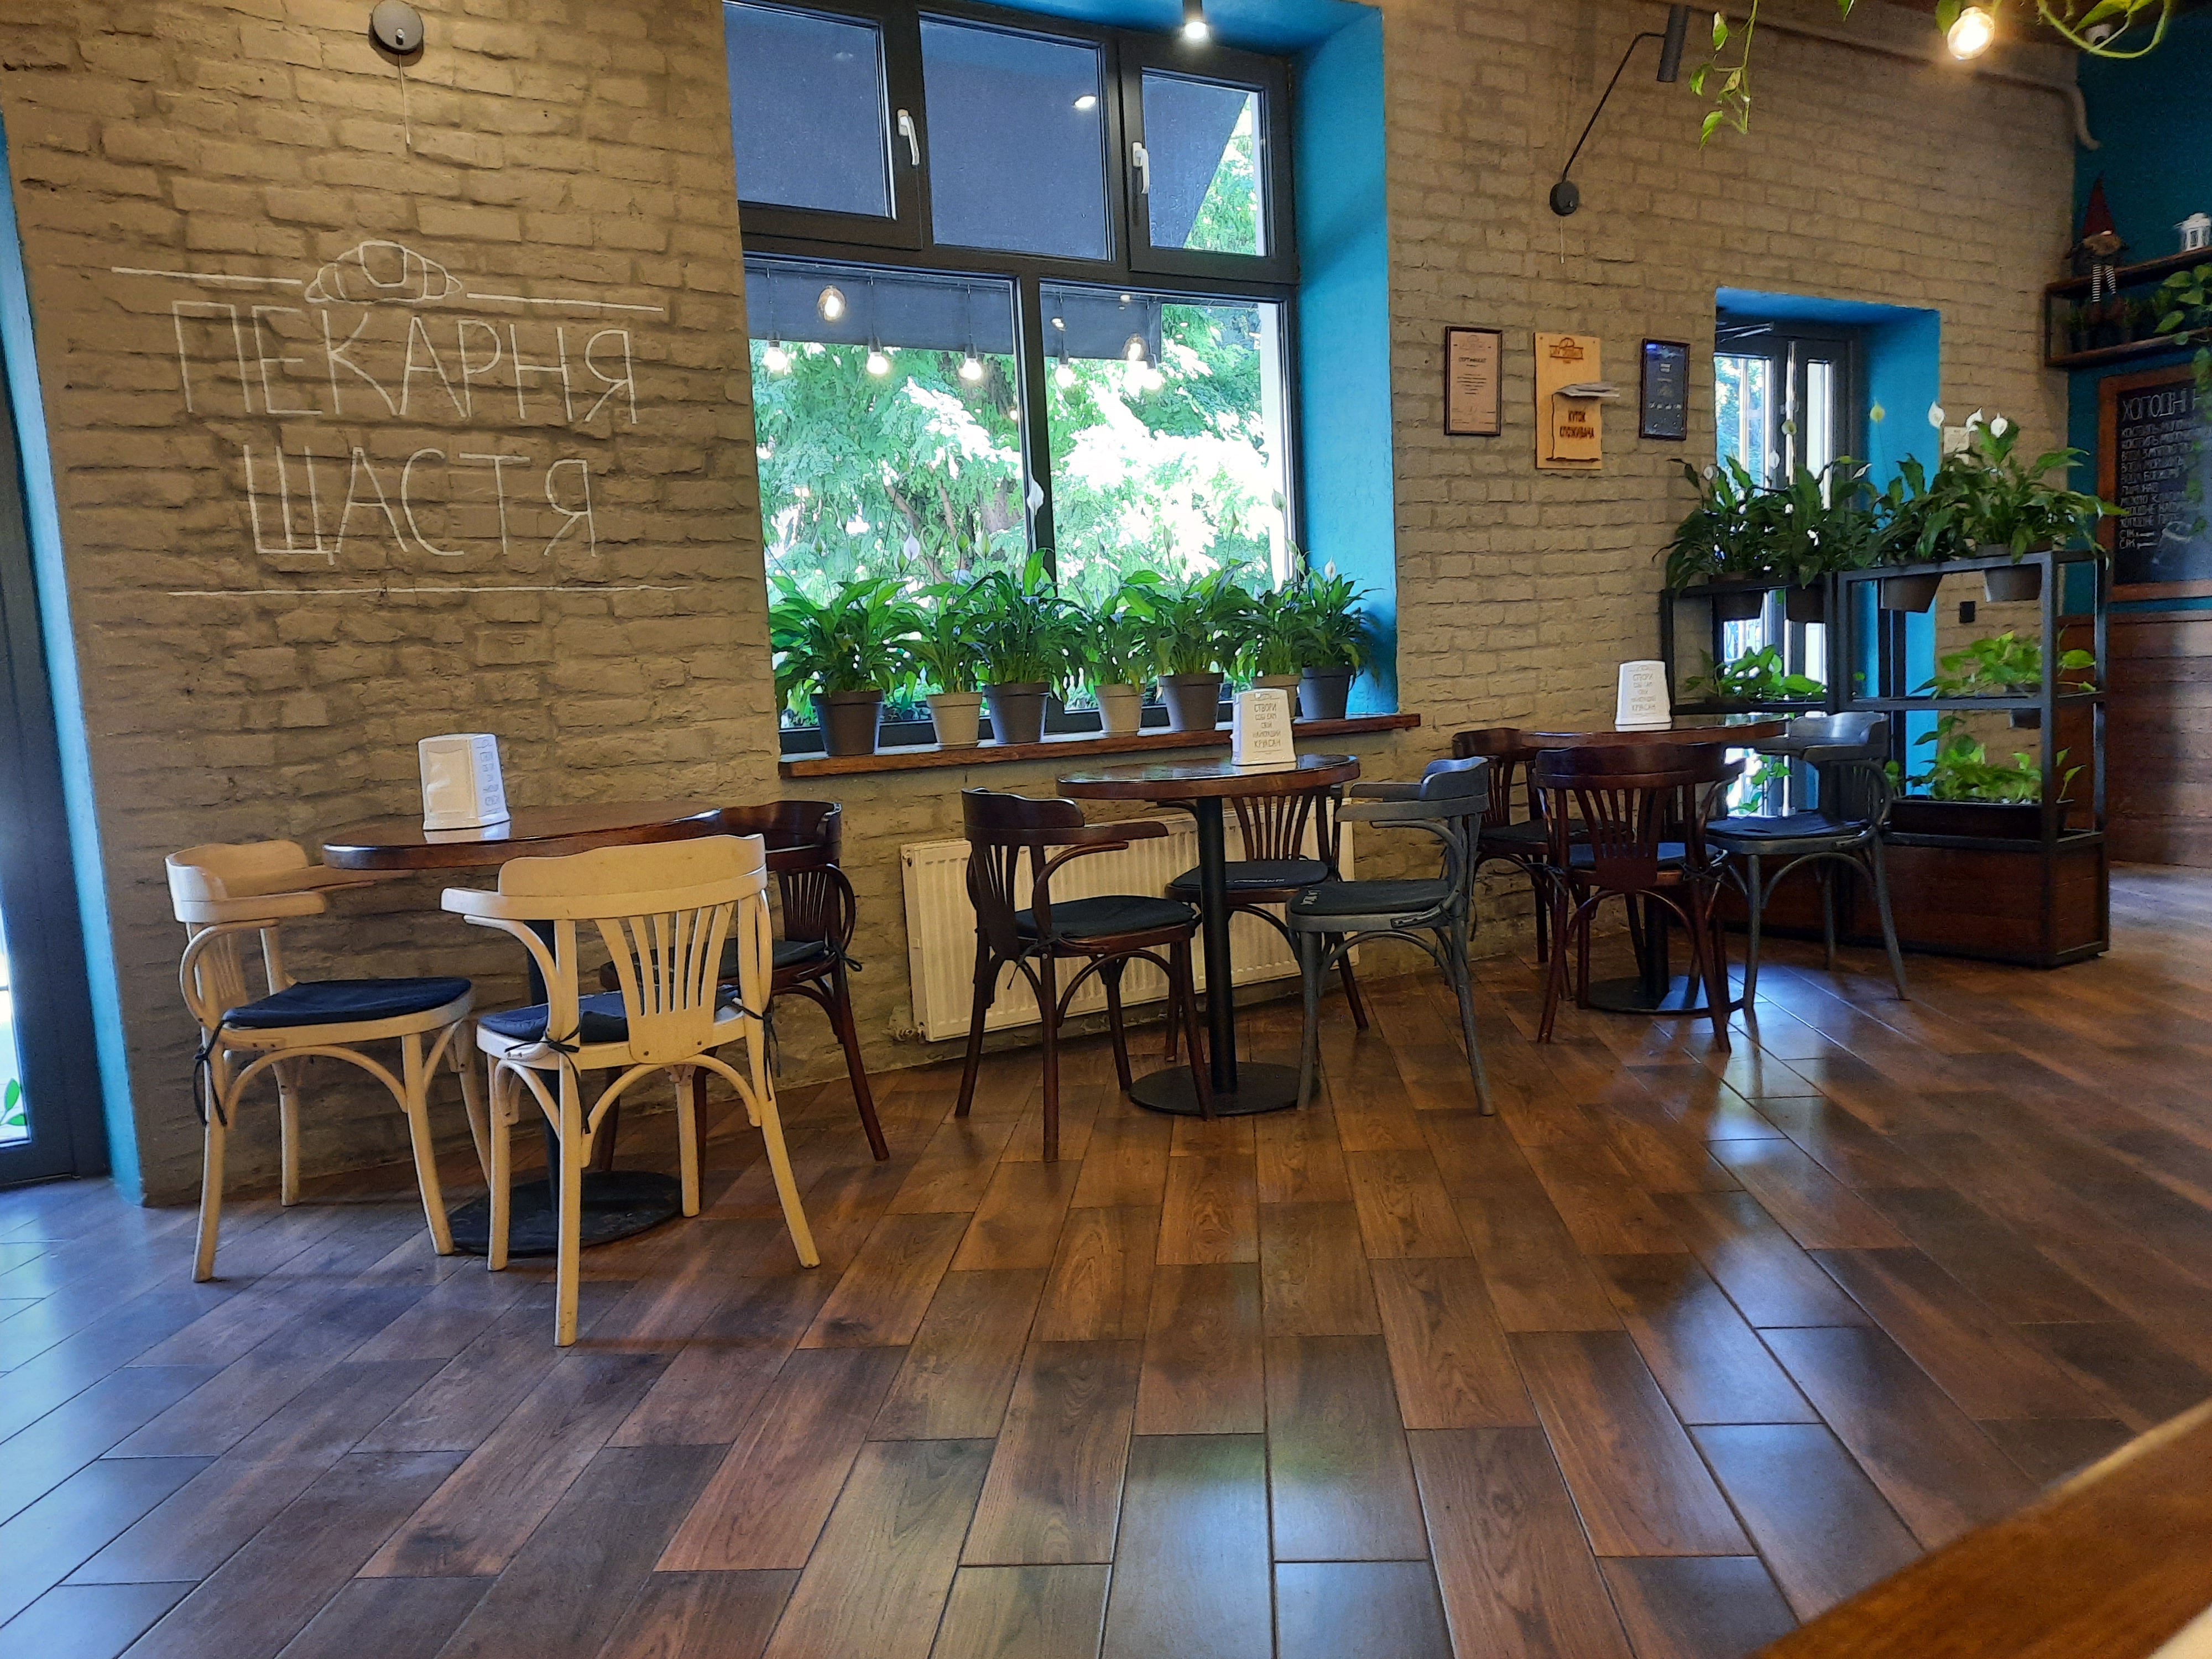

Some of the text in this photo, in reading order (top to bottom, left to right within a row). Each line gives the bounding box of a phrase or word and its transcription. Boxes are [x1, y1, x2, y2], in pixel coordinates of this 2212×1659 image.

[173, 301, 637, 424] ПЕКАРНЯ
[243, 445, 597, 566] ЩАСТЯ
[1254, 703, 1276, 712] СТВОРИ
